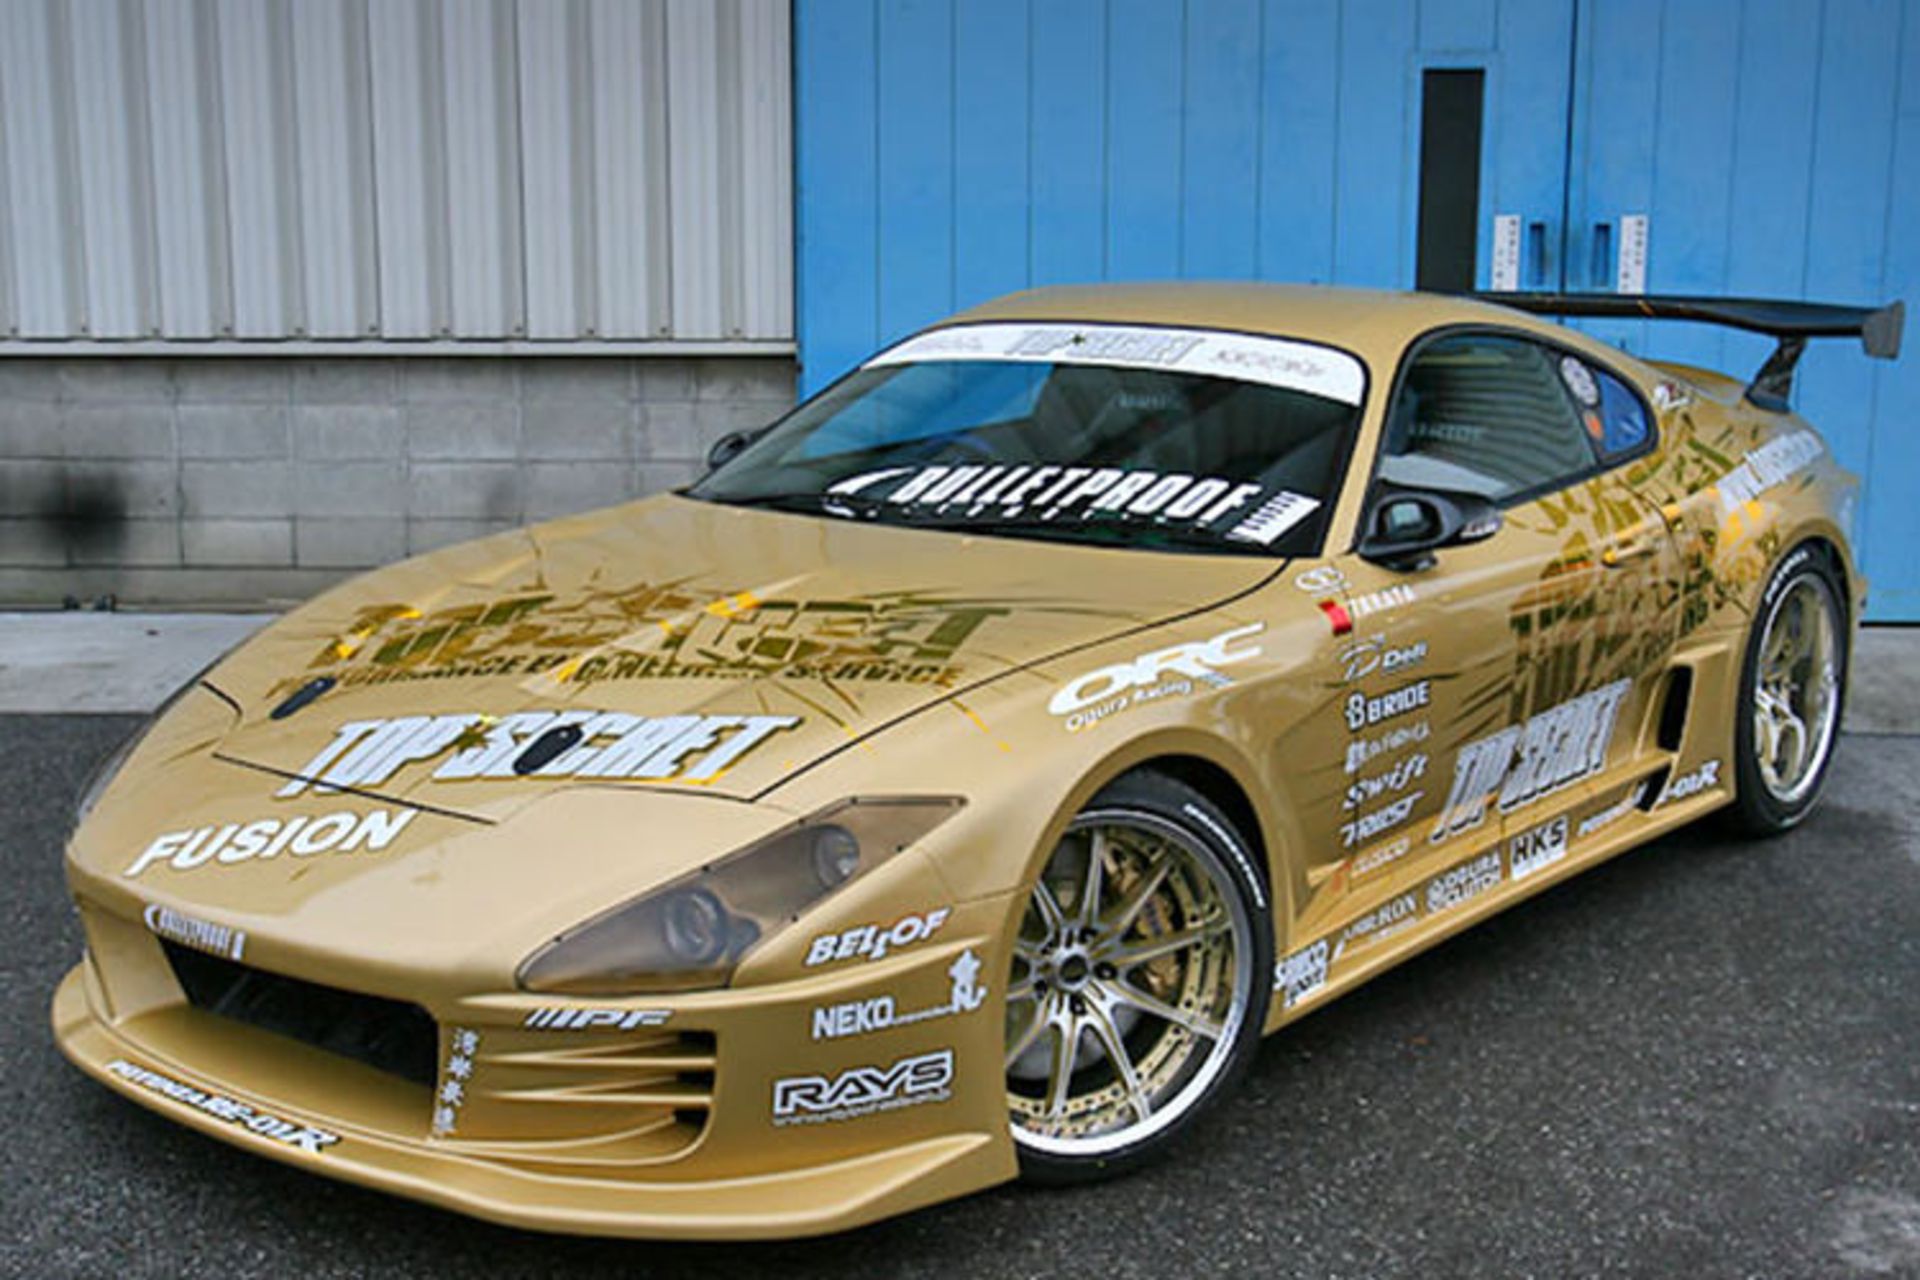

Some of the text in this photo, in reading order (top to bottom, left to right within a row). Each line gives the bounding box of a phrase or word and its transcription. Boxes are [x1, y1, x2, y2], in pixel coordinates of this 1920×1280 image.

[888, 465, 1263, 526] BULLETPROOF
[1048, 621, 1266, 716] ORC
[1367, 681, 1430, 722] BRIDE
[123, 808, 420, 878] FUSION
[1512, 817, 1565, 866] HKS
[811, 996, 896, 1040] NEKO
[773, 1049, 954, 1115] RAYS
